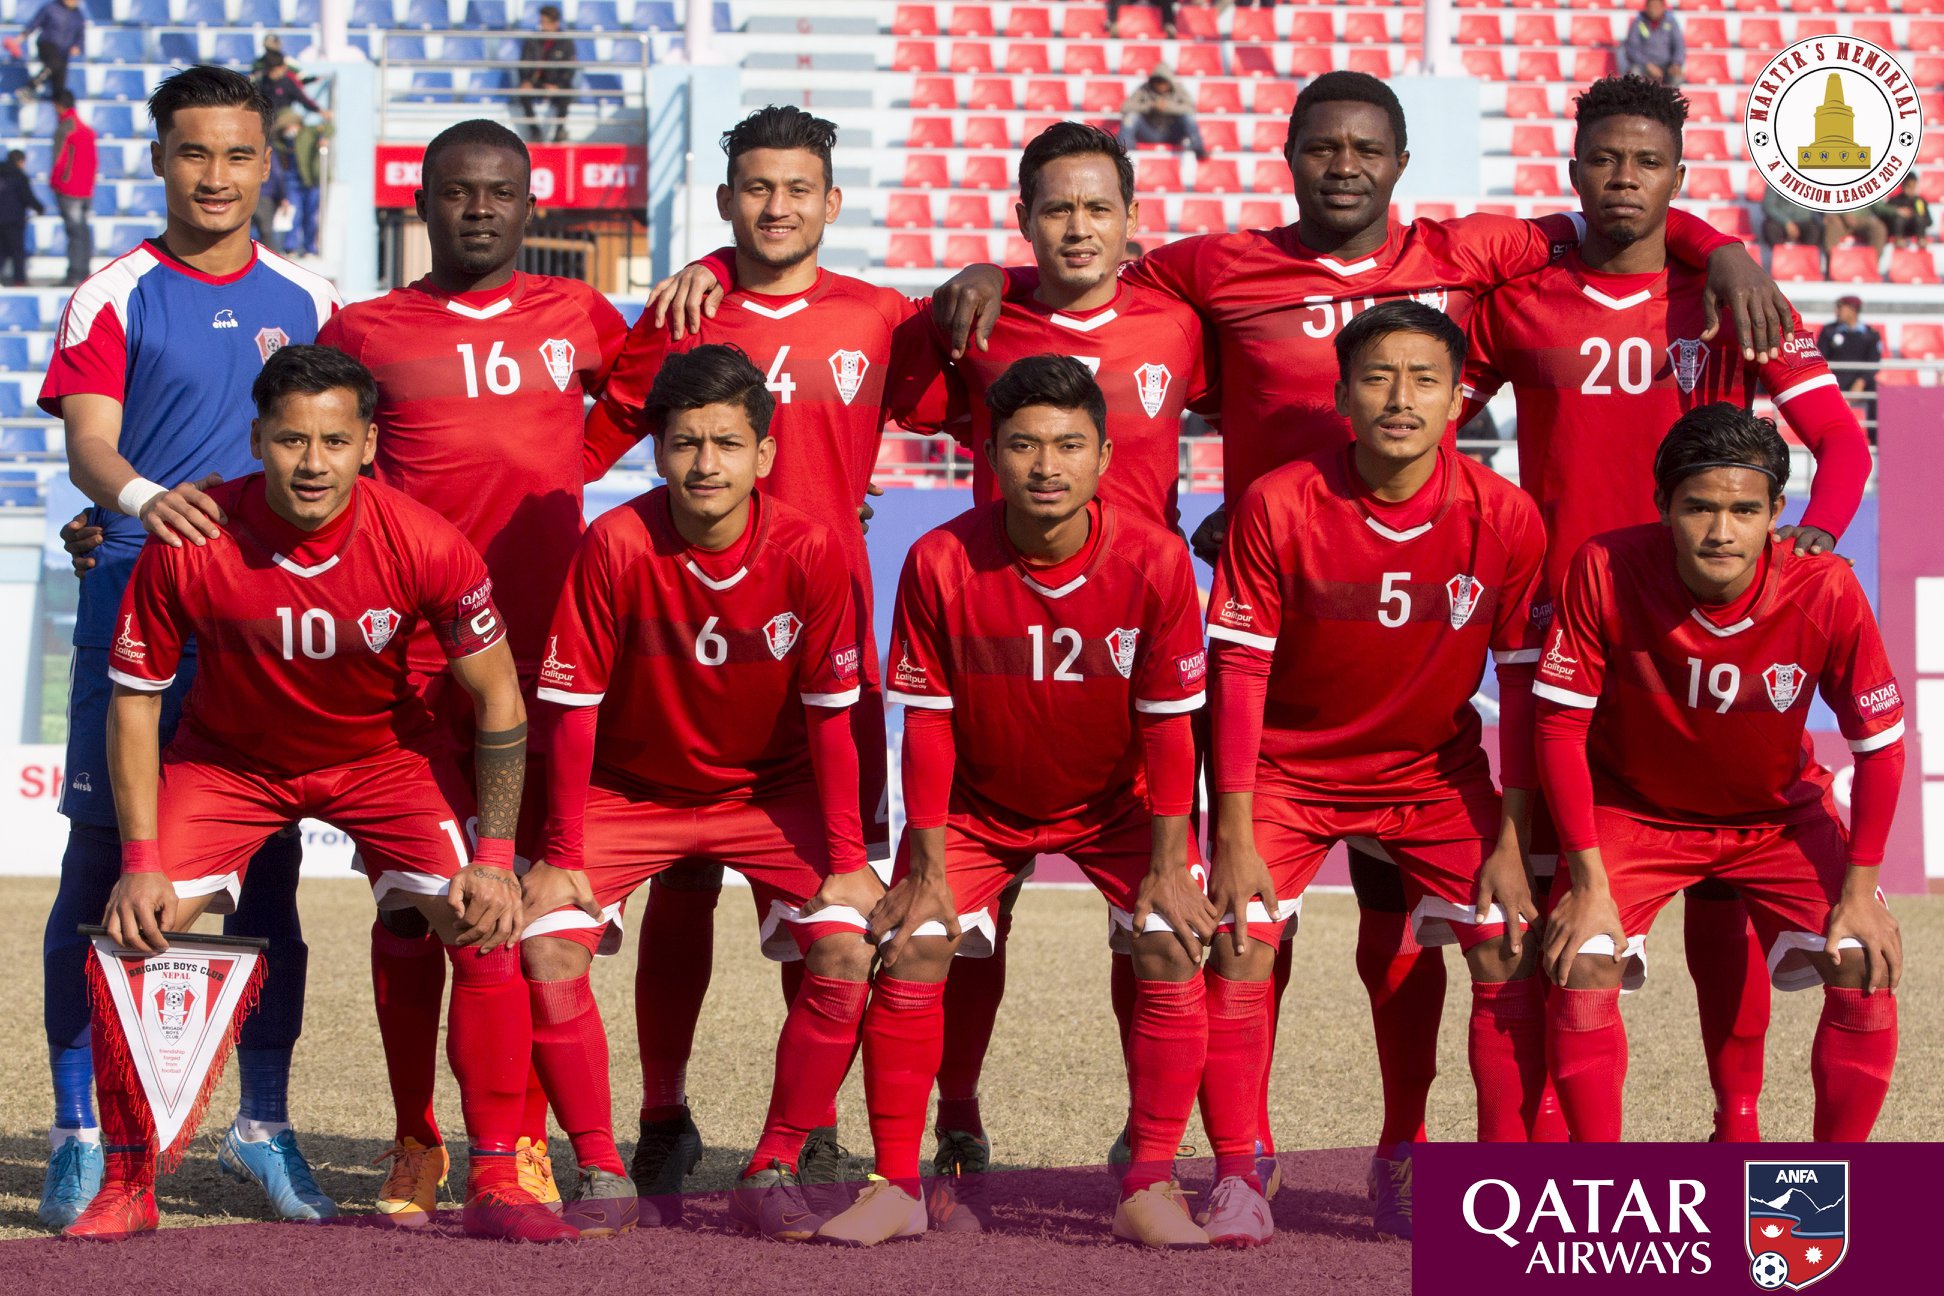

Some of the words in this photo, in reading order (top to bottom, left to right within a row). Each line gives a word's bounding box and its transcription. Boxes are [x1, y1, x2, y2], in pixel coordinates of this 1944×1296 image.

[583, 163, 639, 187] EXIT
[457, 341, 521, 398] 16
[764, 346, 796, 404] 4
[1580, 337, 1651, 395] 20
[1378, 572, 1411, 628] 5
[470, 607, 496, 635] C
[276, 607, 336, 660] 10
[696, 616, 728, 665] 6
[115, 644, 146, 659] Lalitpur
[835, 648, 860, 666] QATA
[1028, 625, 1084, 682] 12
[1180, 652, 1205, 671] QATAR
[541, 668, 575, 681] Lalitpur
[895, 672, 928, 684] Lalitpur
[1543, 661, 1576, 675] Lalitpur
[1687, 657, 1740, 714] 19
[1860, 684, 1898, 707] QATAR
[1871, 694, 1901, 714] AIRWAYS
[128, 962, 170, 978] BRIGADE
[173, 962, 198, 972] BOYS
[200, 966, 225, 982] CLUB
[161, 971, 191, 980] NEPAL
